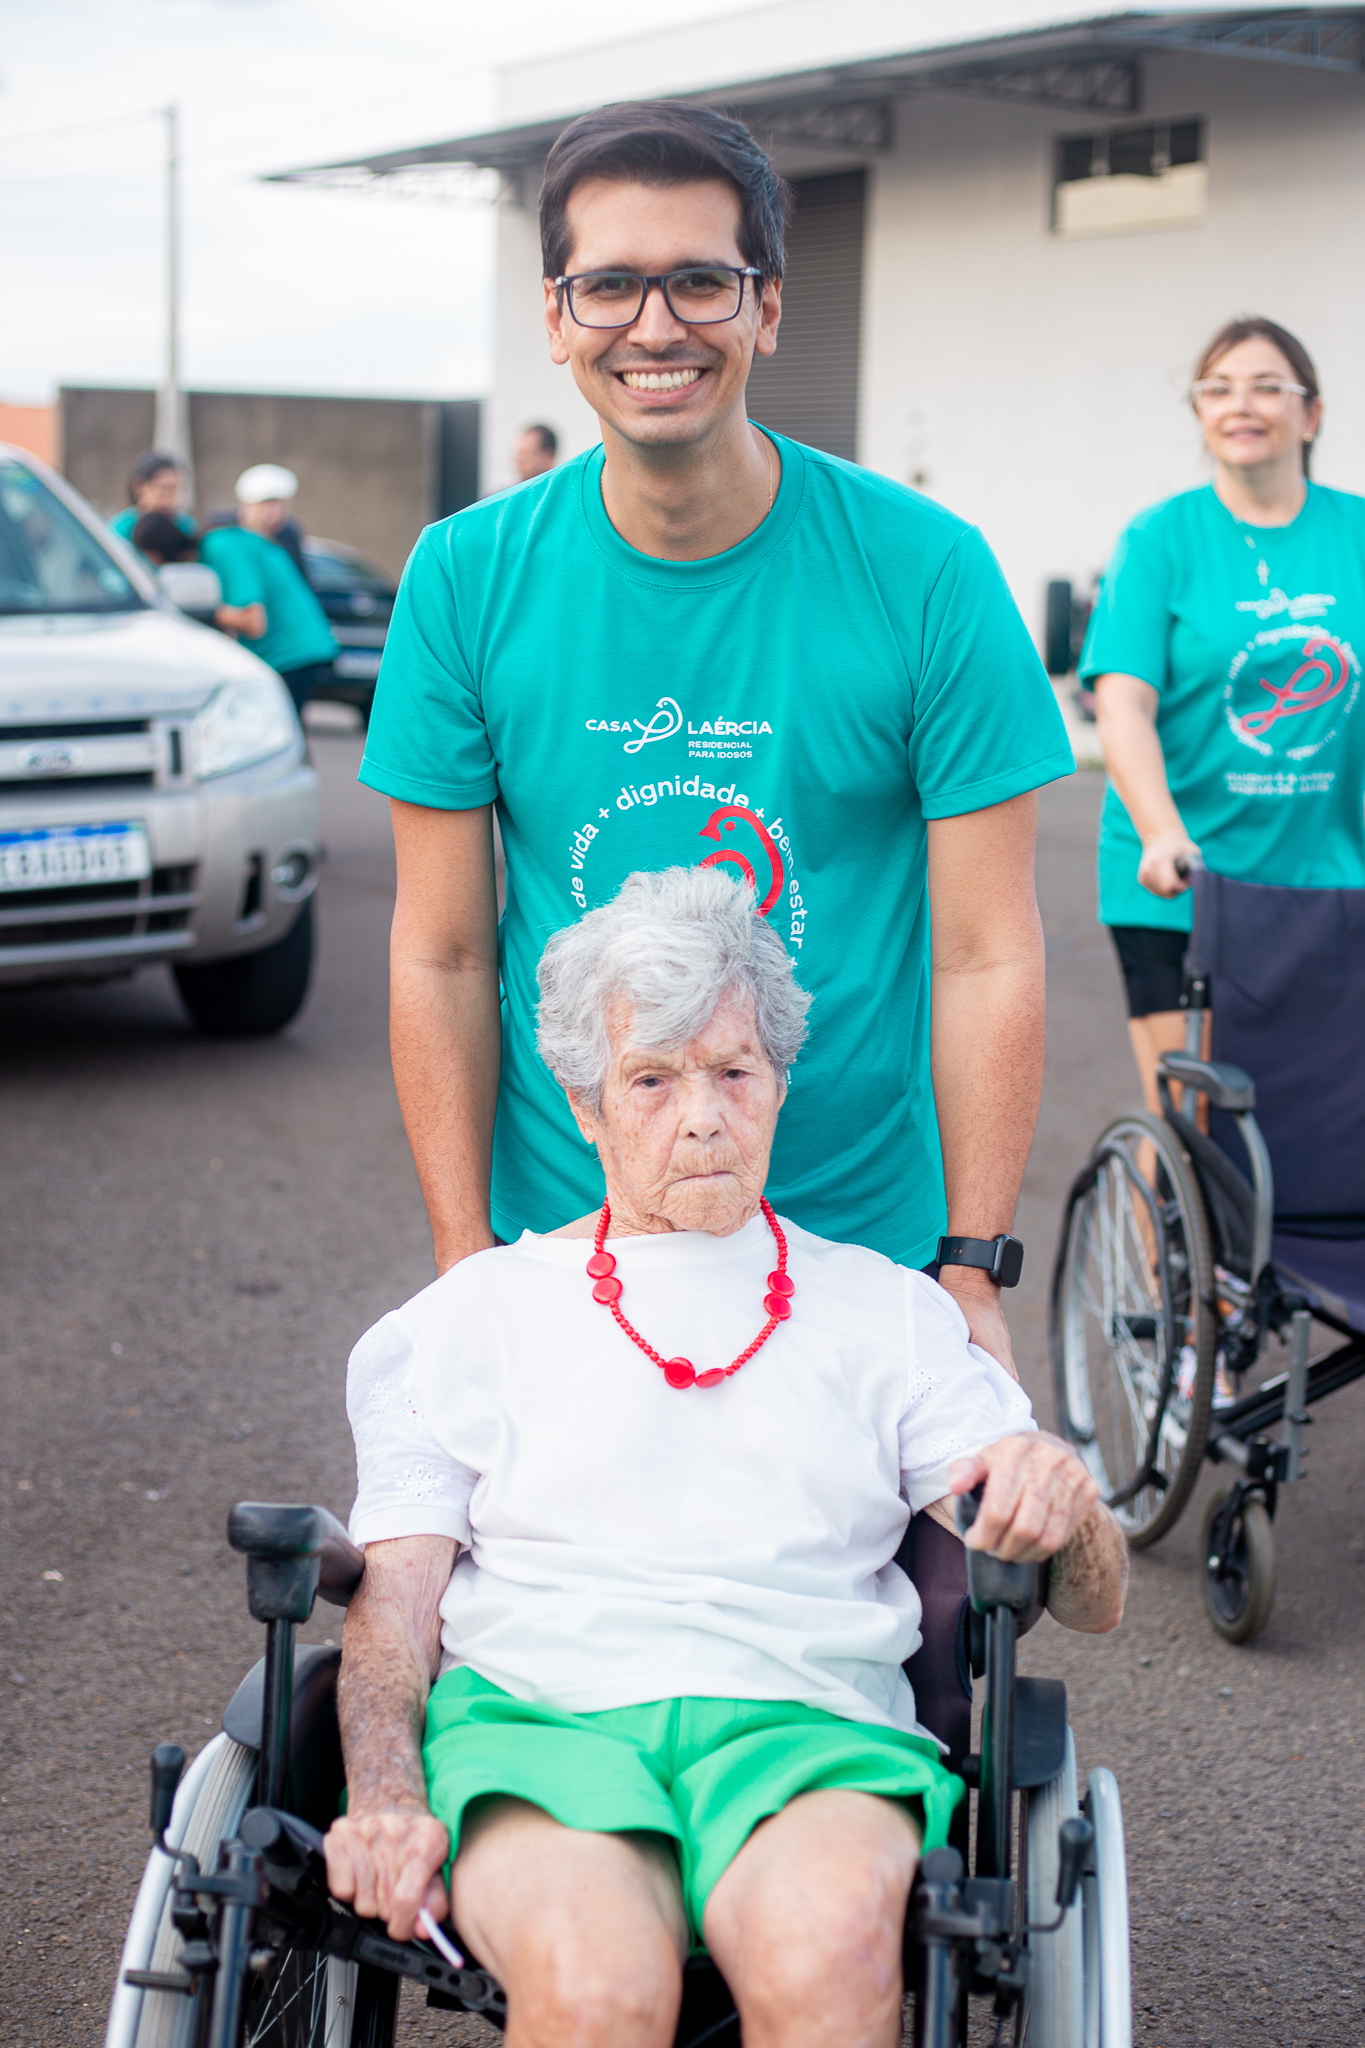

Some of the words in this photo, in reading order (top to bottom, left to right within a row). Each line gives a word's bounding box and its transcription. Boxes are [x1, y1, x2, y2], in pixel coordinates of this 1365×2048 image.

[585, 719, 632, 733] CASA
[687, 716, 773, 736] LAÉRCIA
[688, 741, 752, 749] RESIDENCIAL
[689, 751, 715, 759] PARA
[717, 751, 753, 759] IDOSOS
[616, 775, 750, 811] dignidade
[569, 823, 600, 869] vida
[570, 877, 587, 908] de
[767, 817, 808, 949] bem-estar
